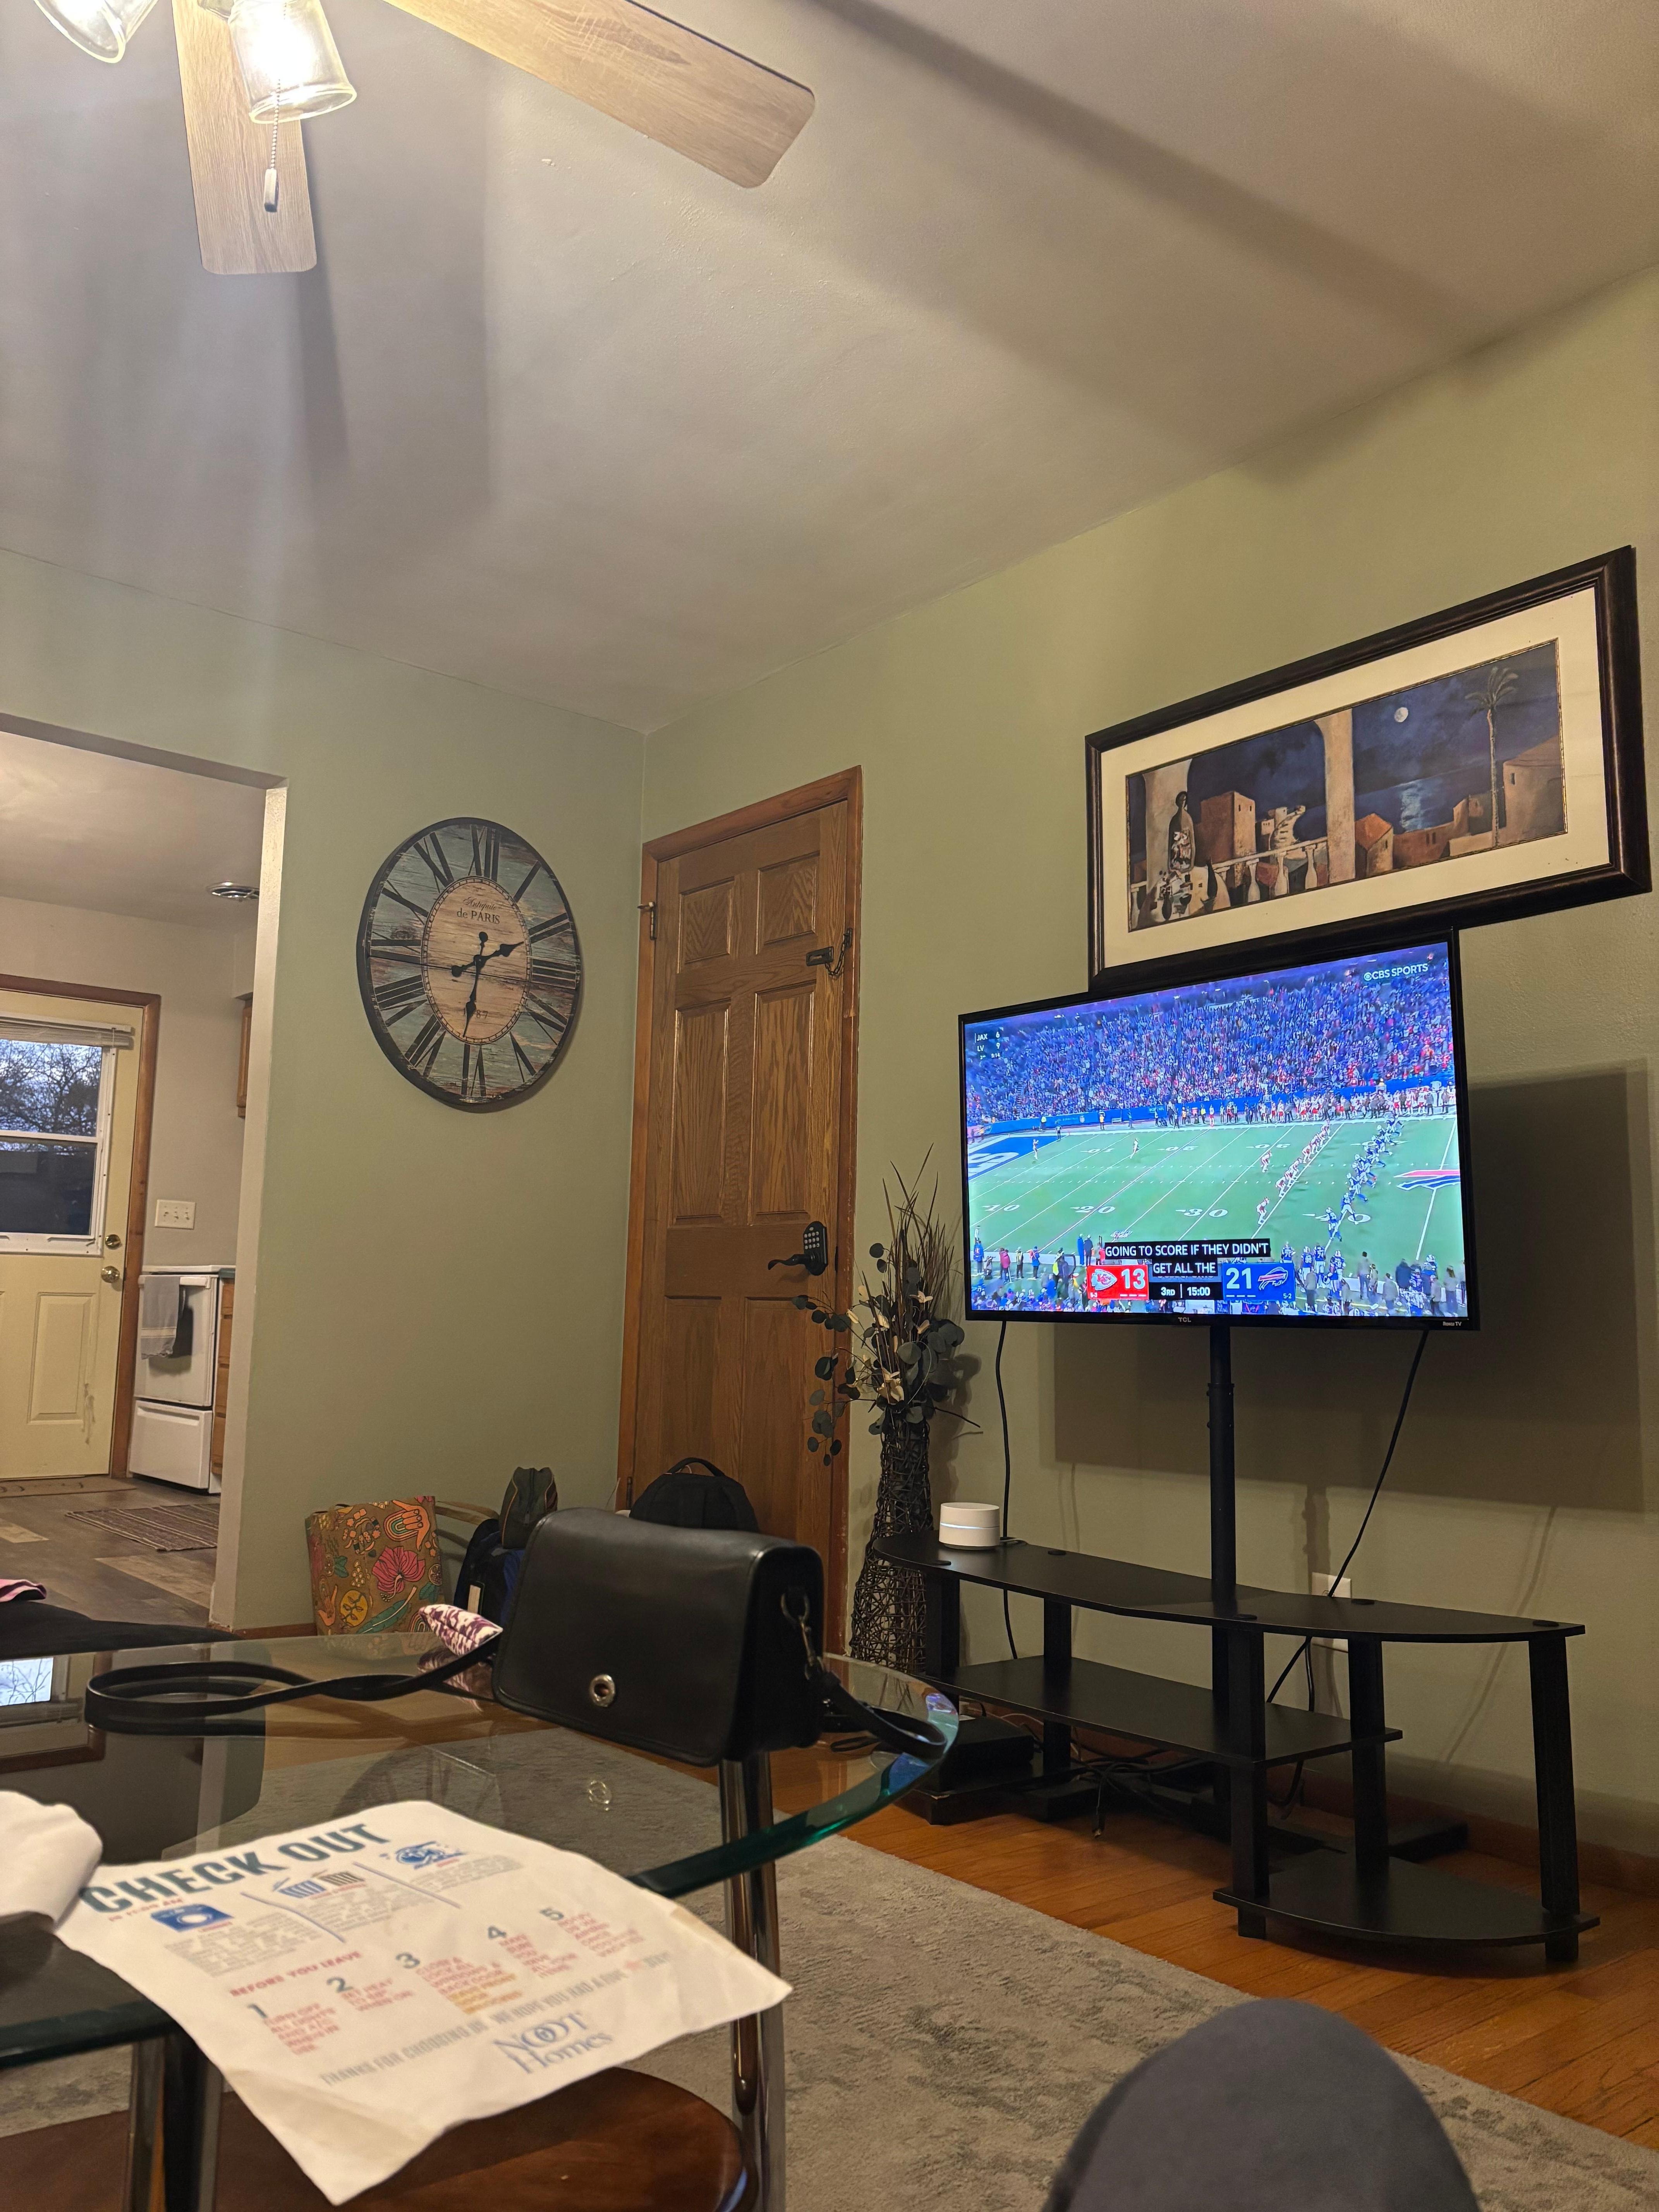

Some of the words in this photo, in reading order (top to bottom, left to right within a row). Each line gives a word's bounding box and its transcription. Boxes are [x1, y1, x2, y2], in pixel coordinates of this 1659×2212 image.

[412, 831, 454, 893] XI
[468, 825, 500, 882] XII
[514, 860, 541, 902] I
[381, 879, 428, 925] X
[457, 908, 468, 918] de
[471, 911, 500, 924] PARIS
[529, 912, 571, 944] II
[368, 931, 422, 963] IX
[532, 958, 577, 989] III
[1371, 969, 1390, 980] CBS
[1391, 963, 1429, 977] SPORTS
[374, 975, 428, 1027] VIII
[463, 1007, 488, 1019] 187
[524, 991, 568, 1046] IV
[404, 1015, 446, 1078] VII
[509, 1030, 536, 1083] V
[461, 1044, 486, 1097] VI
[1105, 1246, 1137, 1257] GOING
[1139, 1245, 1152, 1256] TO
[1155, 1245, 1188, 1256] SCORE
[1190, 1244, 1199, 1255] IF
[1202, 1243, 1229, 1255] THEY
[1232, 1242, 1269, 1255] DIDN'T
[1121, 1268, 1146, 1290] 13
[1153, 1262, 1172, 1274] GET
[1174, 1262, 1194, 1274] ALL
[1195, 1262, 1216, 1273] THE
[1226, 1267, 1252, 1289] 21
[1161, 1286, 1176, 1296] 3RD
[1187, 1286, 1211, 1296] 15:00
[80, 1851, 290, 1913] CHECK
[278, 1823, 391, 1862] OUT
[539, 1907, 564, 1921] 5
[487, 1925, 507, 1939] 4
[230, 1975, 283, 1996] BEFORE
[287, 1964, 318, 1977] YOU
[320, 1951, 361, 1968] LEAVE
[395, 1952, 421, 1969] 3
[326, 1976, 354, 1993] 2
[247, 2003, 268, 2019] 1
